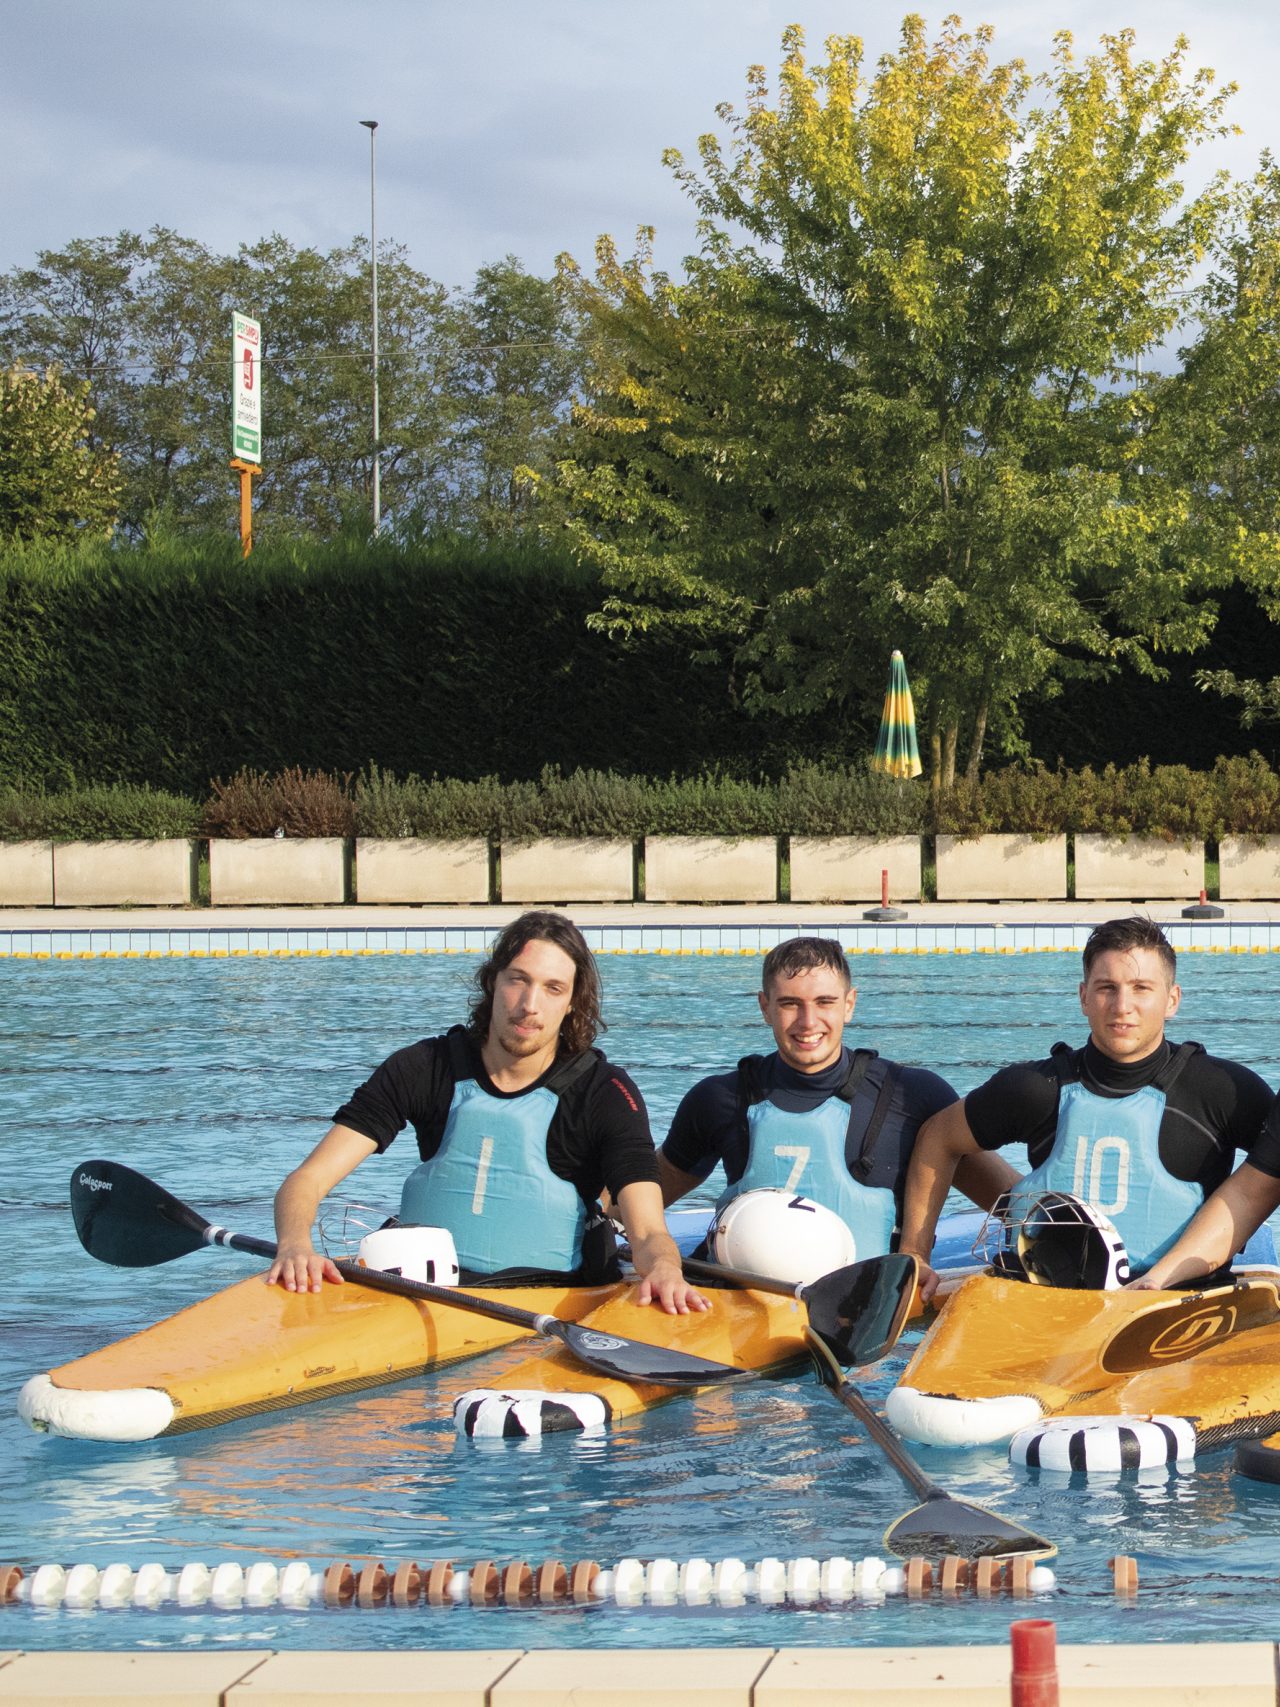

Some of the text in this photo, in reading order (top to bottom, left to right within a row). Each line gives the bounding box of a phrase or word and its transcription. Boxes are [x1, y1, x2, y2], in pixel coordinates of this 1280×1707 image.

[472, 1136, 494, 1215] 1
[774, 1145, 811, 1193] 7
[1073, 1135, 1130, 1216] 10
